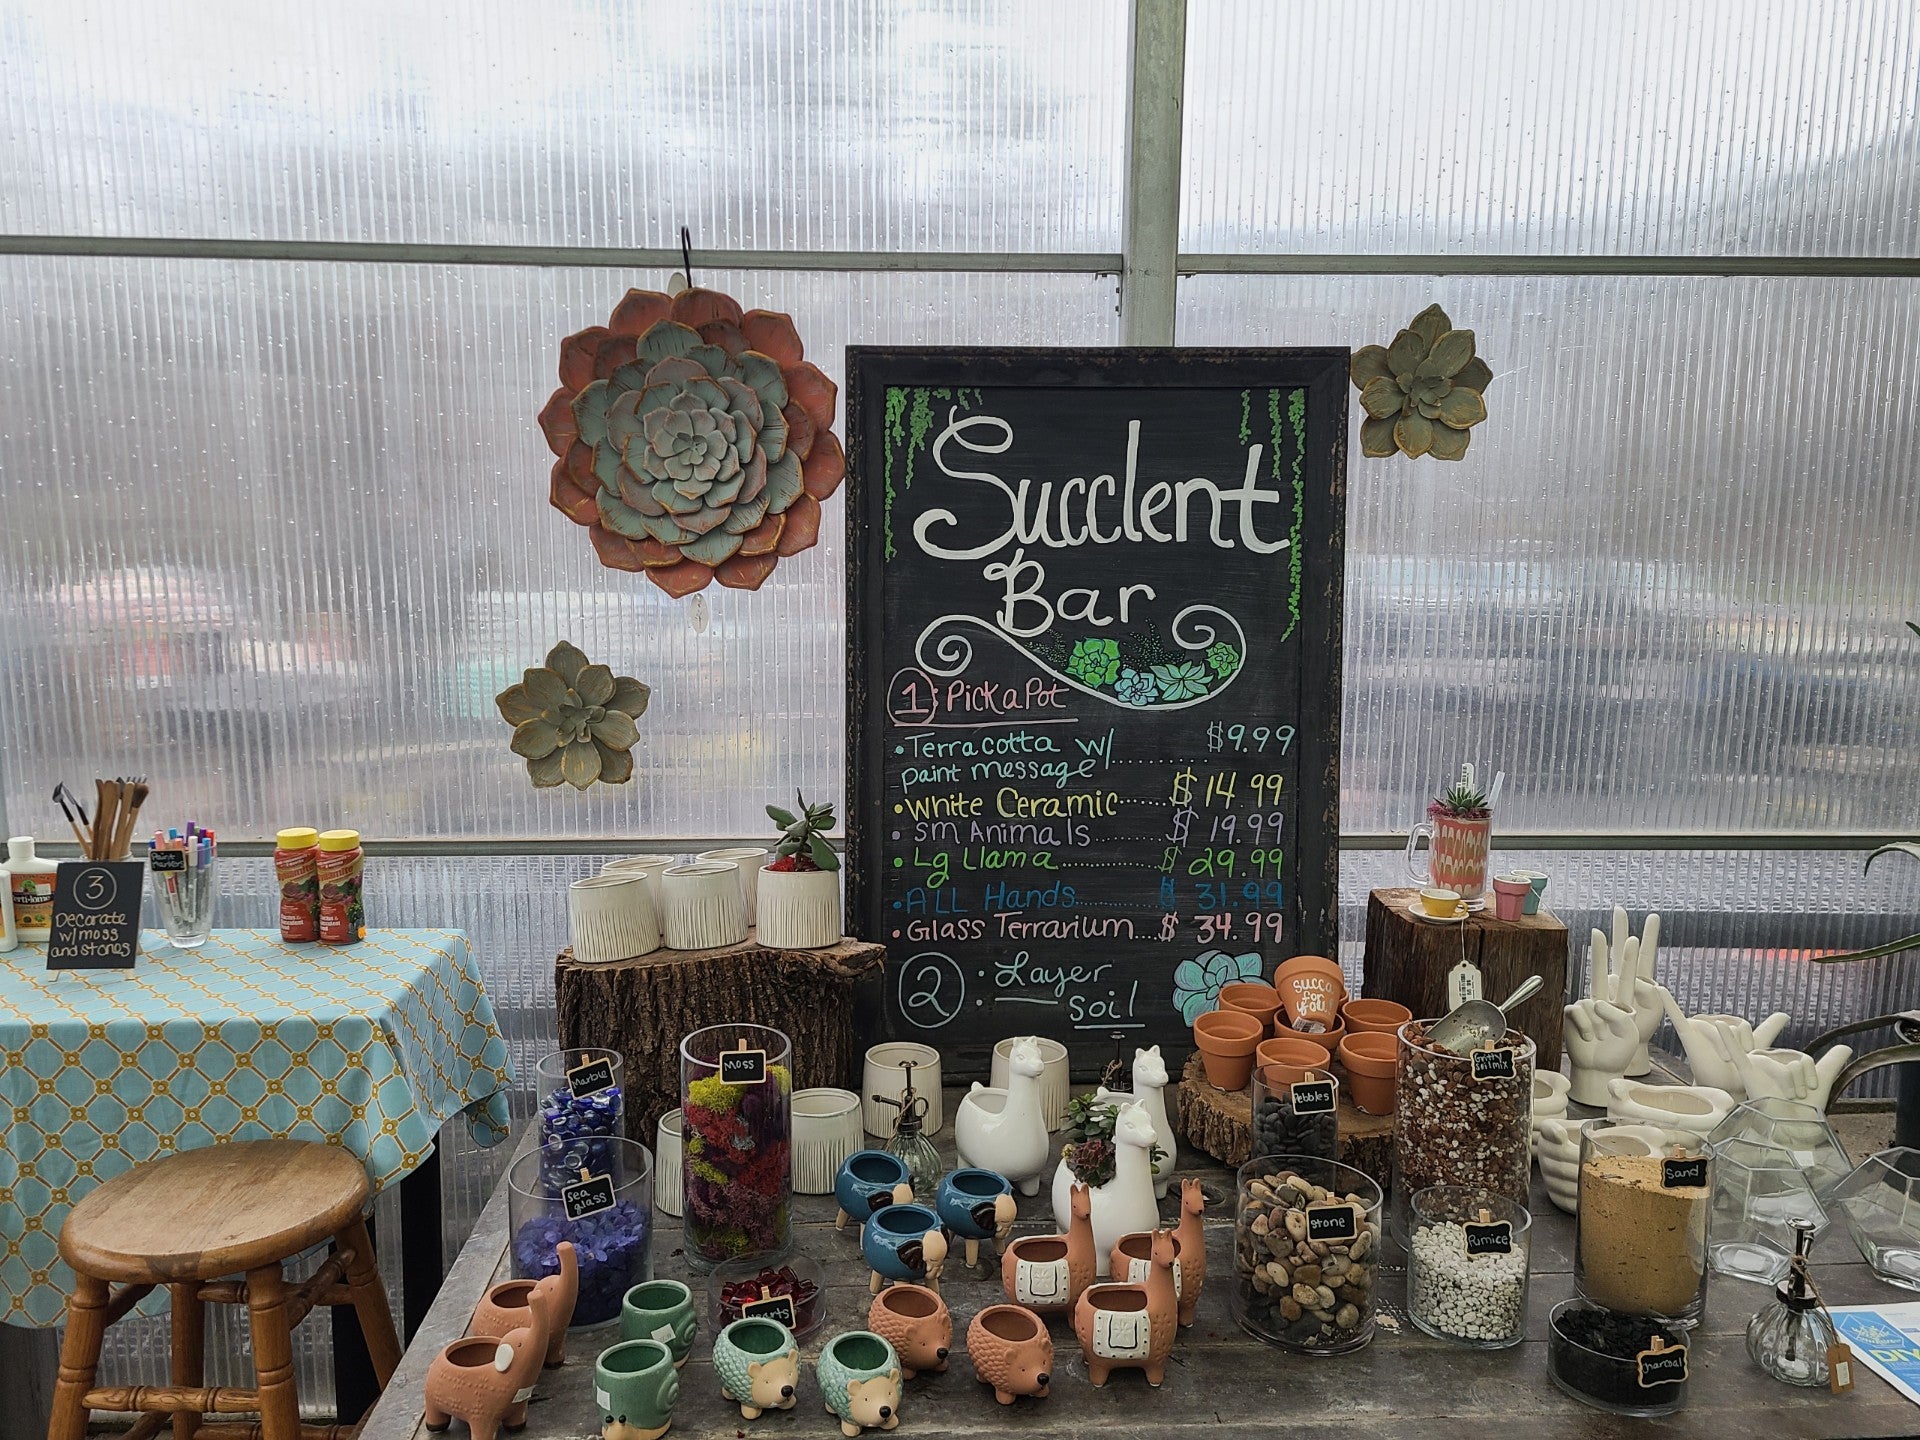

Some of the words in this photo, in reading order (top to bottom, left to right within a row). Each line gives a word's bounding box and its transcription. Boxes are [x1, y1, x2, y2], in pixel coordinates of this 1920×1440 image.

[913, 406, 1290, 560] Succlent
[983, 548, 1156, 638] Bar
[1025, 677, 1070, 710] Pot
[1206, 721, 1296, 756] $9.99
[901, 763, 962, 794] paint
[971, 759, 1097, 789] message
[996, 786, 1119, 819] Ceramic
[970, 818, 1091, 847] Animals
[914, 846, 950, 889] Lg
[963, 845, 1059, 871] Llama
[85, 875, 105, 900] 3
[905, 886, 969, 915] ALL
[984, 880, 1077, 912] Hands
[55, 911, 128, 928] Decorate
[78, 928, 119, 942] moss
[906, 918, 986, 942] Glass
[993, 911, 1134, 941] Terrarium
[50, 944, 79, 958] and
[80, 941, 131, 958] stones
[994, 950, 1113, 998] Layer
[1302, 990, 1325, 1004] for
[571, 1070, 608, 1089] Marble
[574, 1192, 607, 1216] glass
[1467, 1233, 1508, 1248] Pumice
